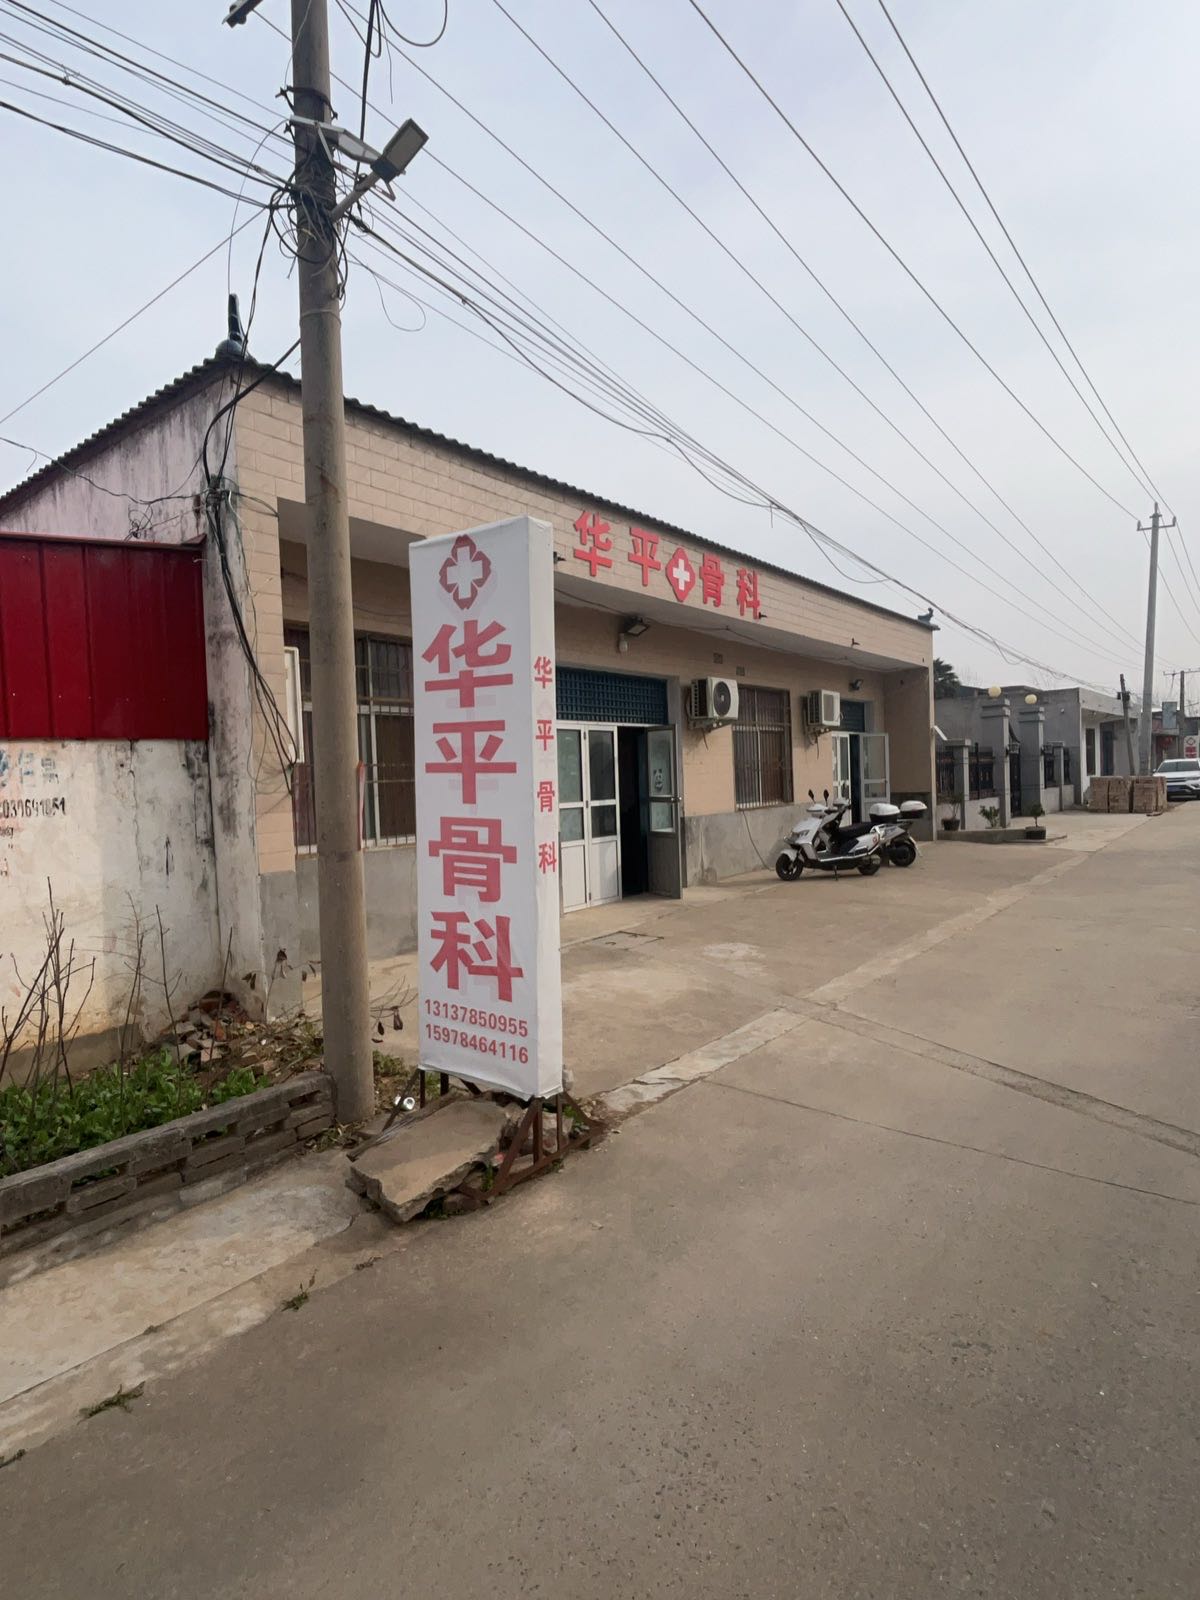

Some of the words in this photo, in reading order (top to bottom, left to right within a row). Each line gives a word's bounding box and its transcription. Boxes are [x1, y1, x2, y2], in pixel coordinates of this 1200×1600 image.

[573, 510, 760, 619] 华平骨科
[421, 618, 524, 1002] 华平骨科
[533, 655, 557, 875] 华平骨科
[425, 998, 528, 1037] 13137850955
[426, 1023, 529, 1064] 15978464116
